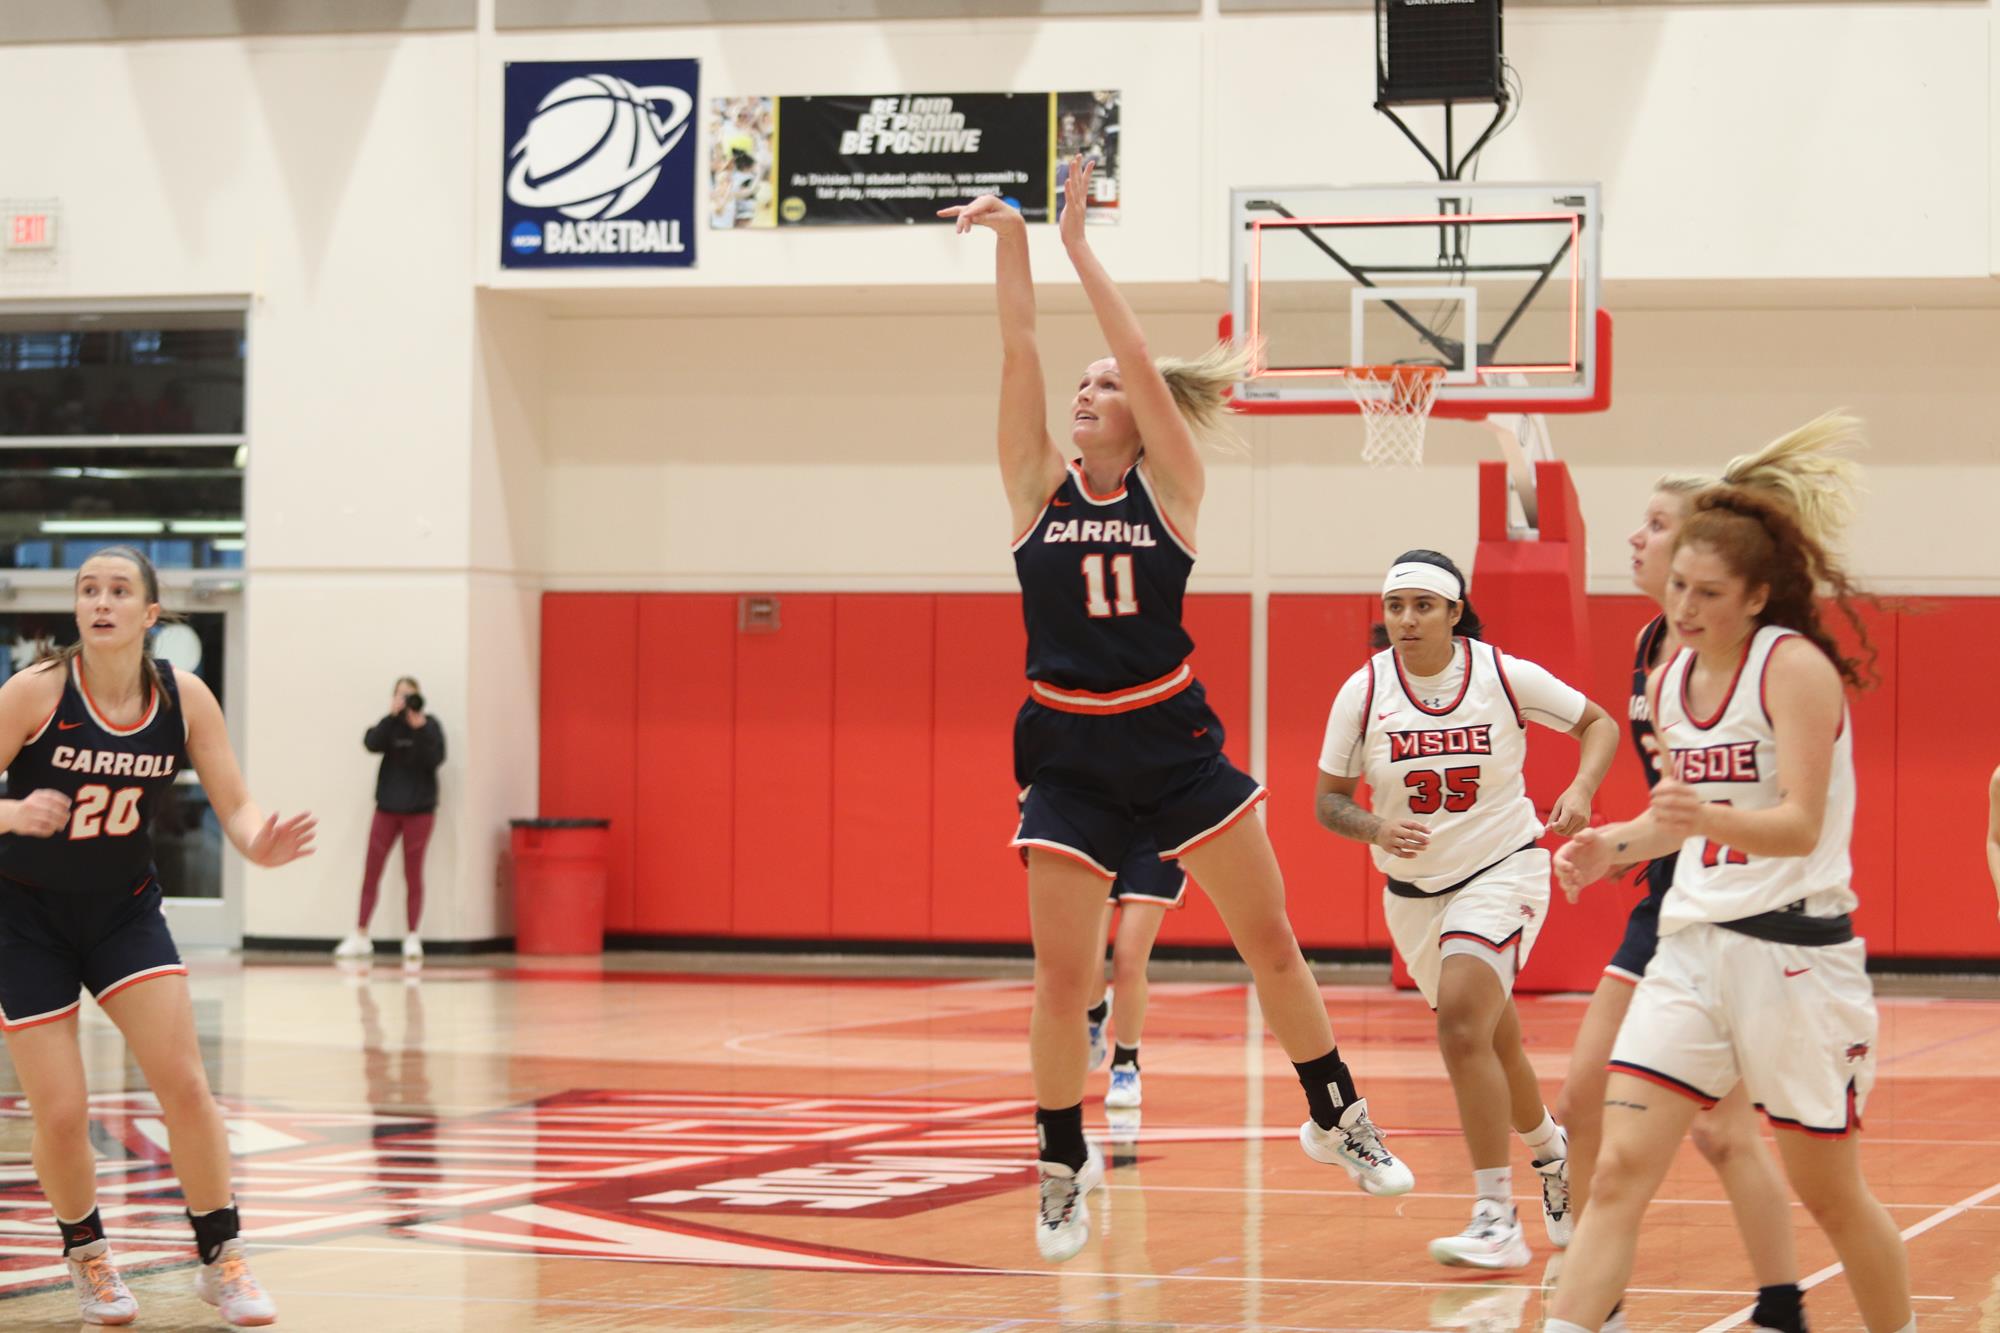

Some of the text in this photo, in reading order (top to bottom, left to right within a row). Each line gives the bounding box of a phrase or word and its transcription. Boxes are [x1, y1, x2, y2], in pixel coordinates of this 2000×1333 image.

[858, 112, 965, 133] BE PROUD
[869, 97, 953, 115] BE LOUD
[840, 129, 982, 154] BE POSITIVE
[808, 172, 852, 187] Division
[15, 214, 47, 243] EXIT
[544, 220, 685, 254] BASKETBALL
[1081, 553, 1140, 618] 11
[1389, 725, 1491, 761] MSOE
[51, 745, 175, 778] CARROLL
[1404, 765, 1480, 815] 35
[68, 783, 144, 841] 20
